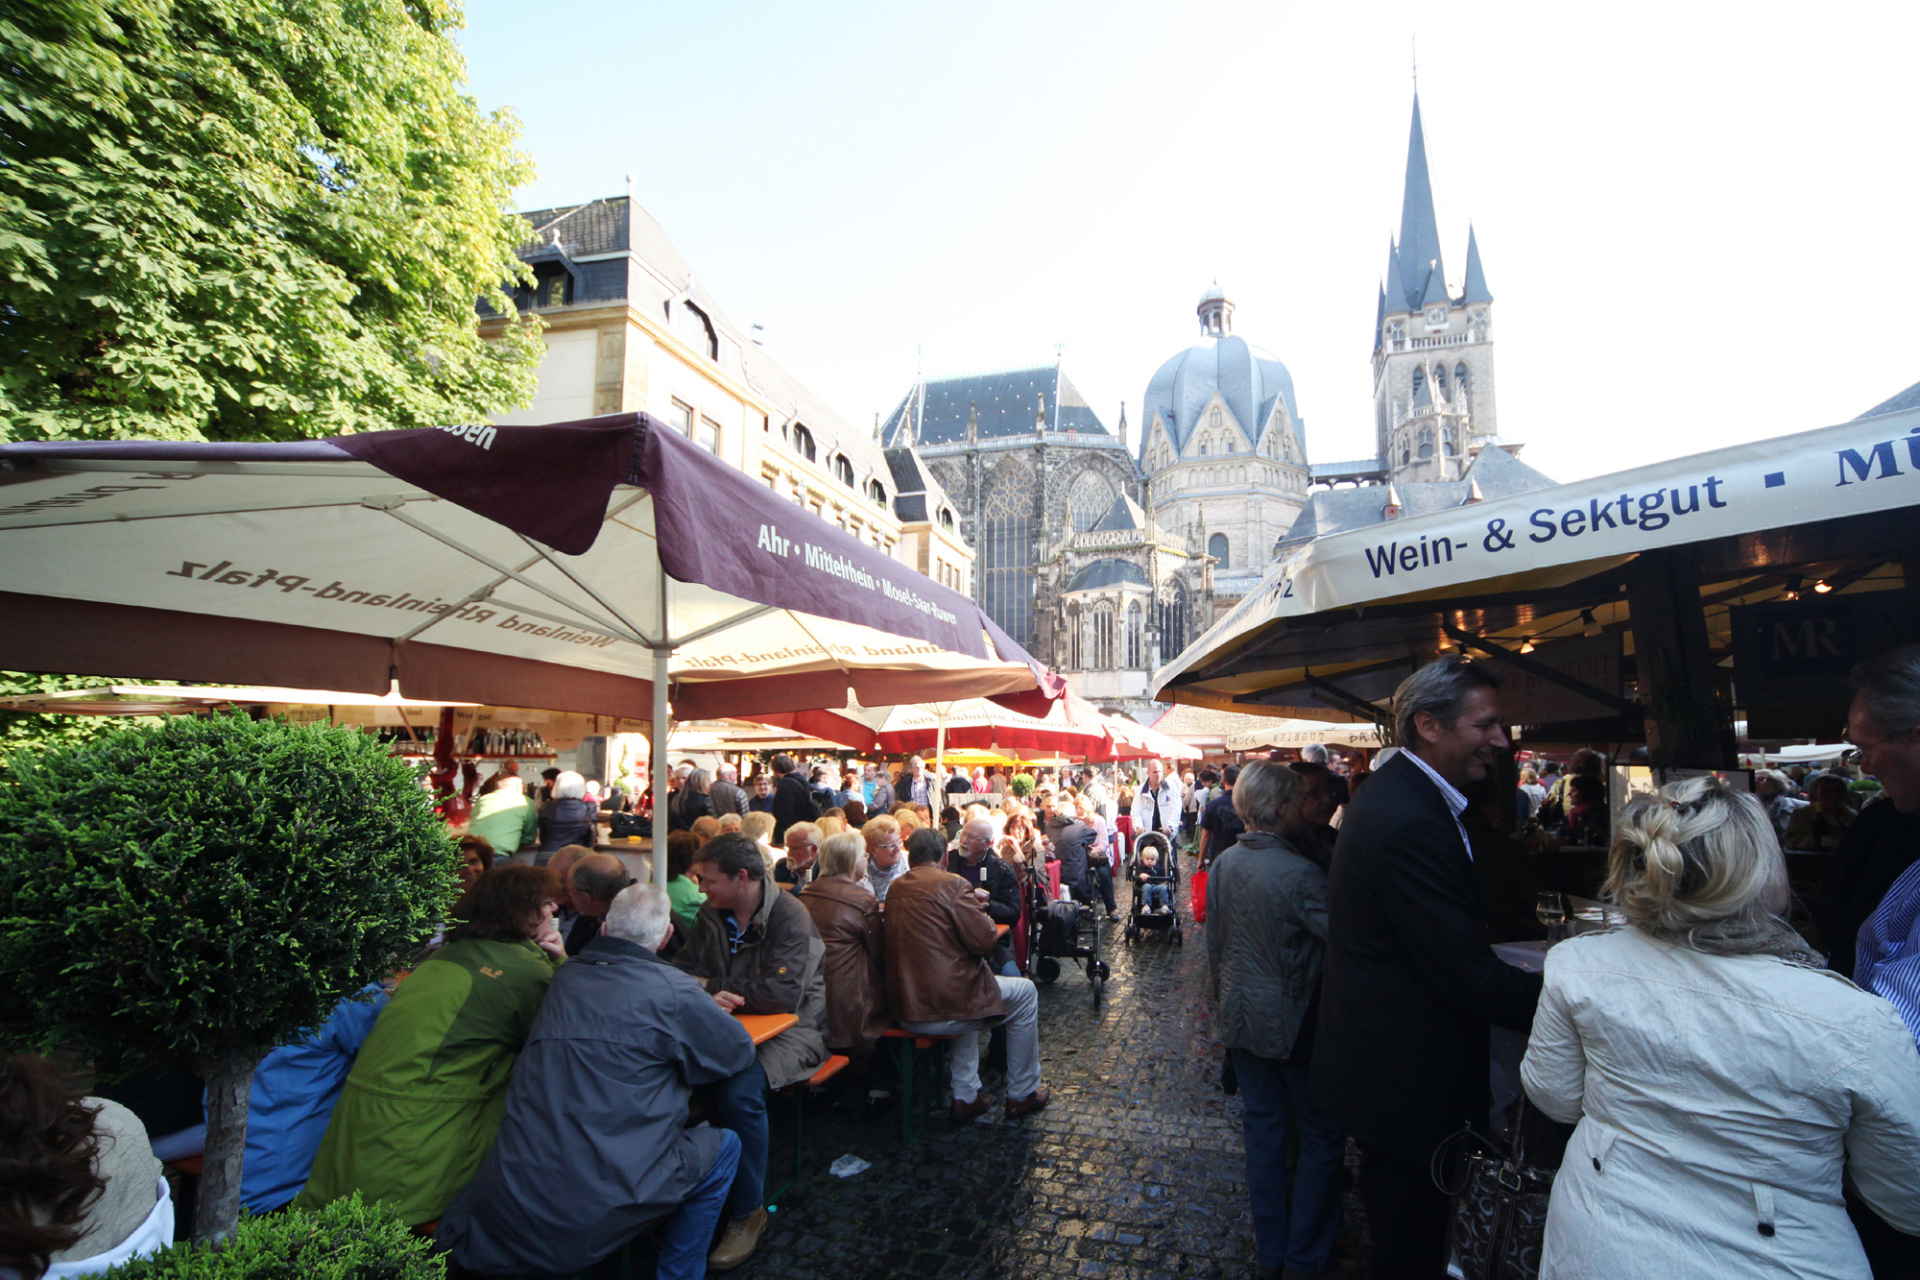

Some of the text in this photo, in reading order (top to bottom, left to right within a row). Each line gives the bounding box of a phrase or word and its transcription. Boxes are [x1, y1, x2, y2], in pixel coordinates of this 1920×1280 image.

[1365, 535, 1468, 579] Wein-
[1483, 518, 1516, 553] &
[1528, 476, 1727, 544] Sektgut
[757, 524, 957, 626] Ahr Mittelrhein Mosel-Saar-Ruwer
[1771, 618, 1843, 660] MR
[456, 711, 491, 721] Weigut
[1272, 732, 1325, 742] WEINGUT
